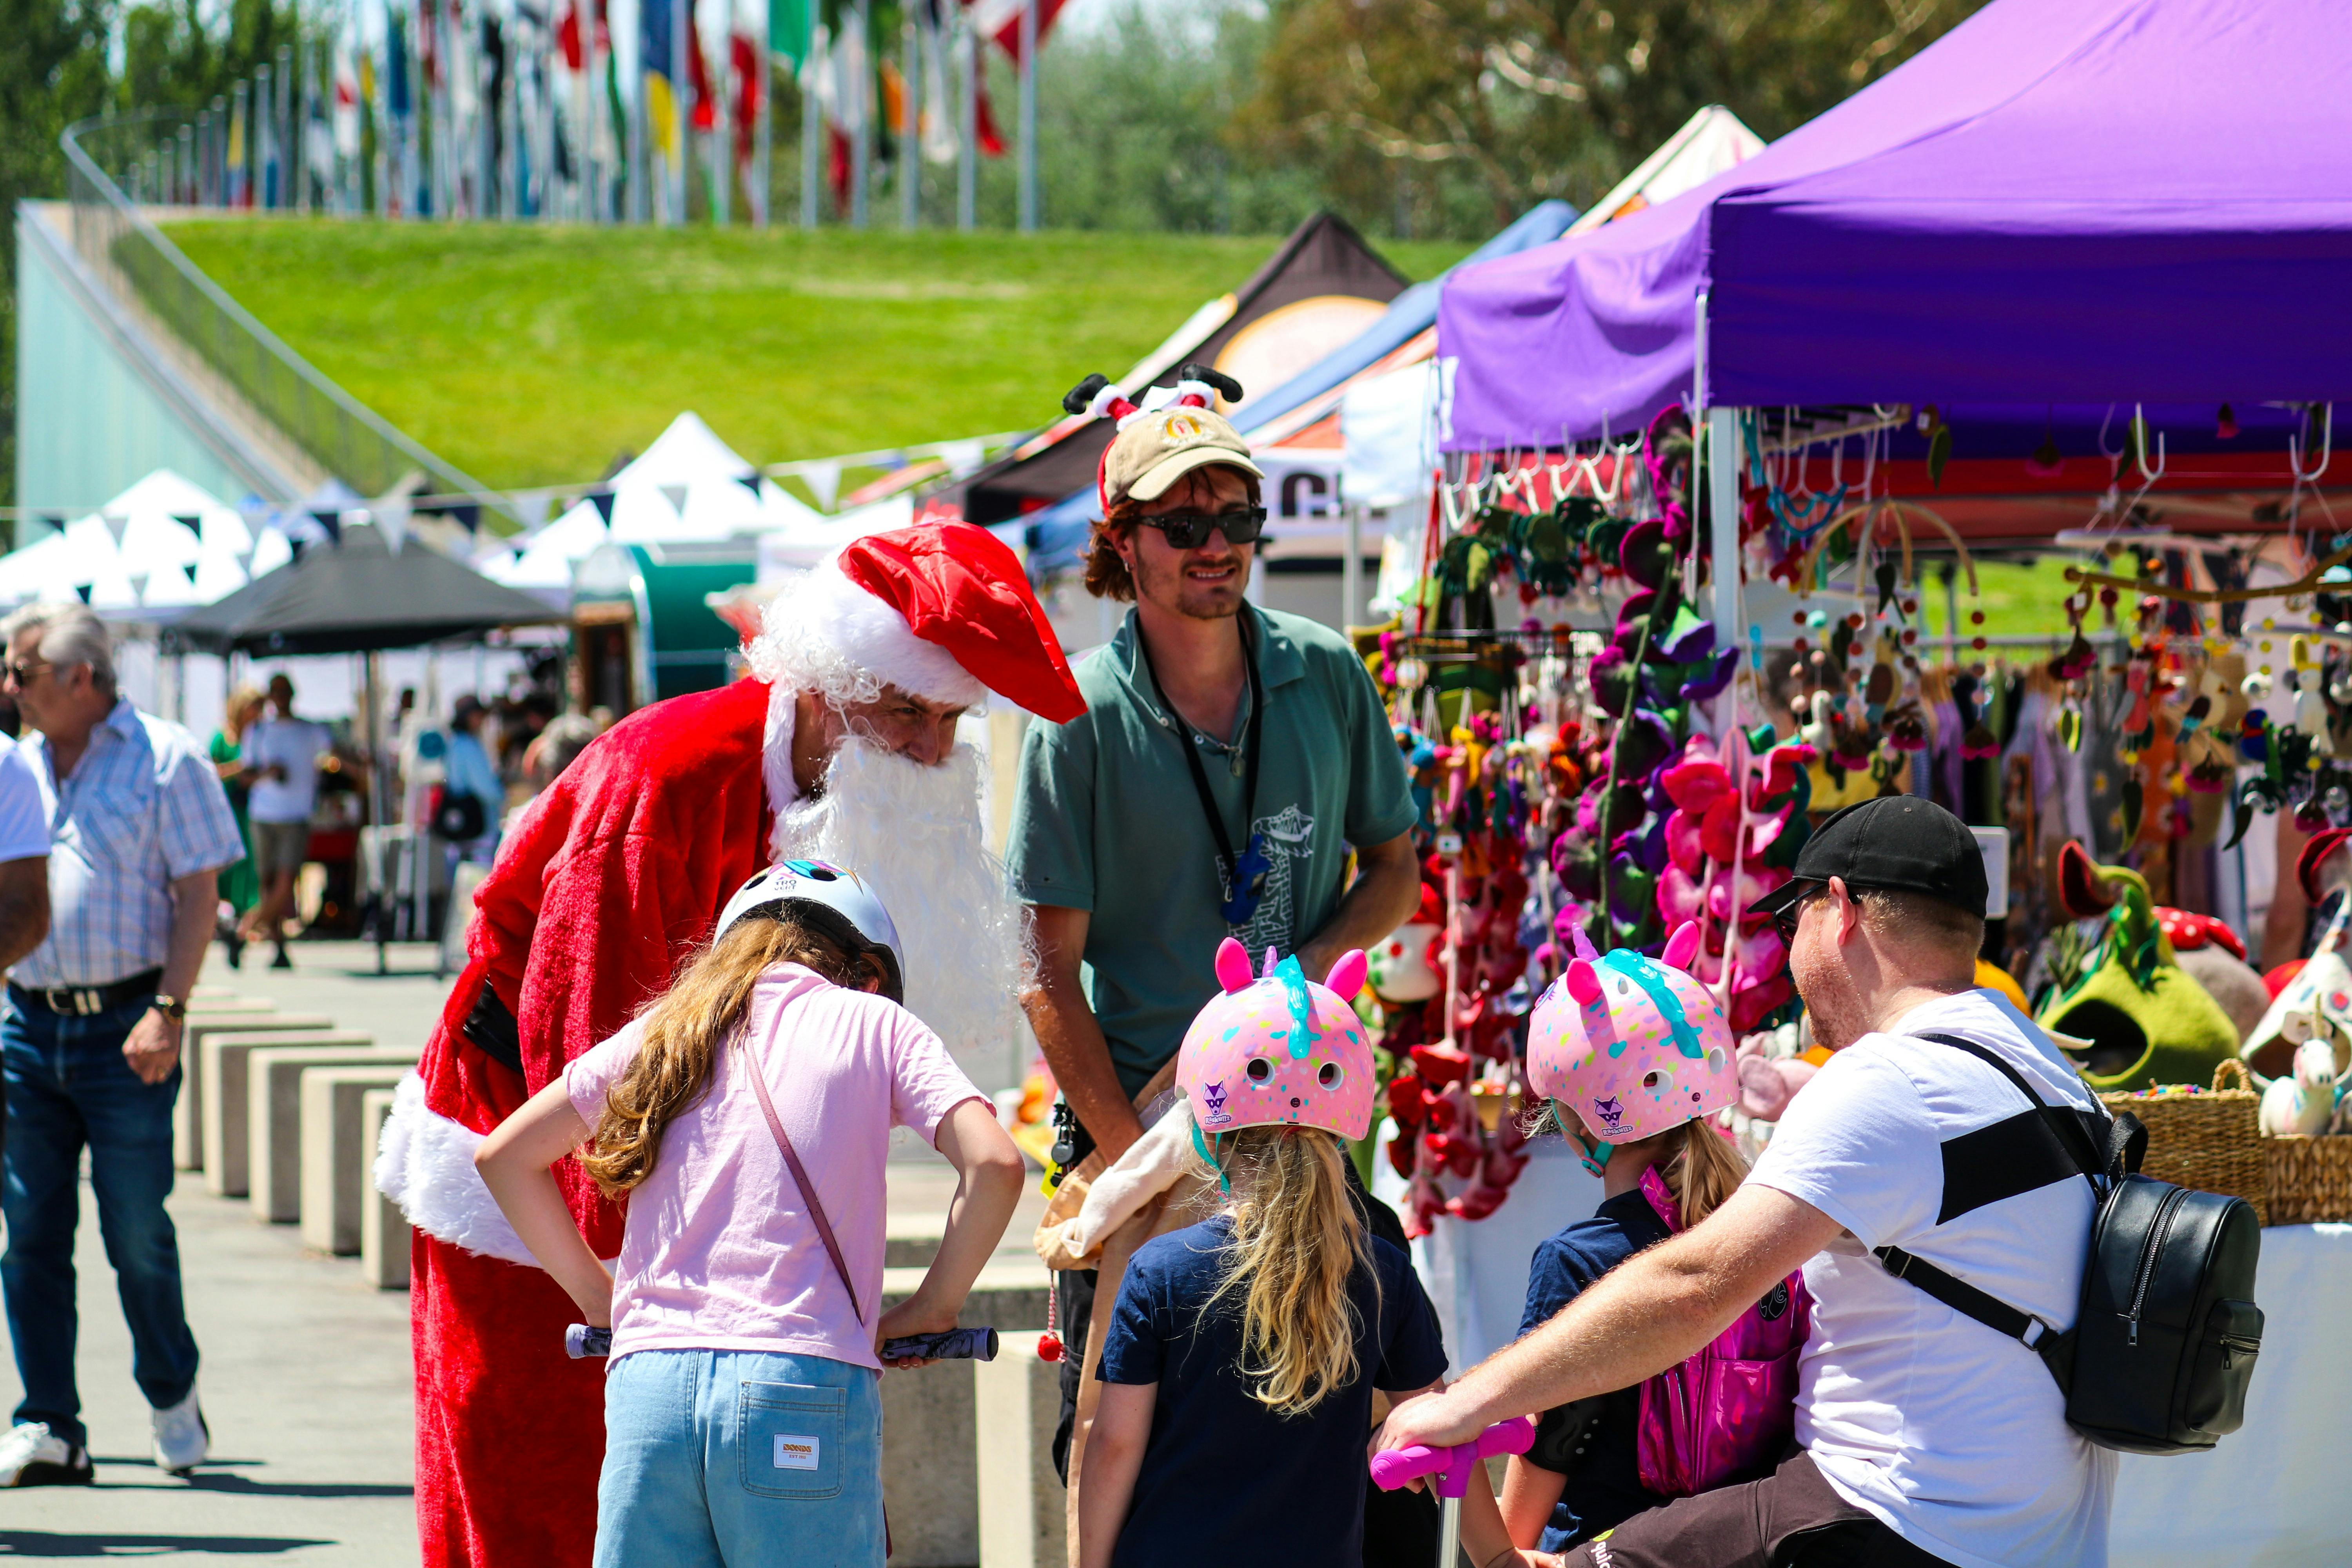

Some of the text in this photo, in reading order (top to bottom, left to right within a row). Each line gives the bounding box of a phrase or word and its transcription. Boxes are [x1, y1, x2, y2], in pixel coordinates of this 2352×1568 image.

[1205, 1115, 1231, 1124] Raskullz
[1602, 1126, 1633, 1136] Raskullz
[783, 1444, 811, 1452] BONDS
